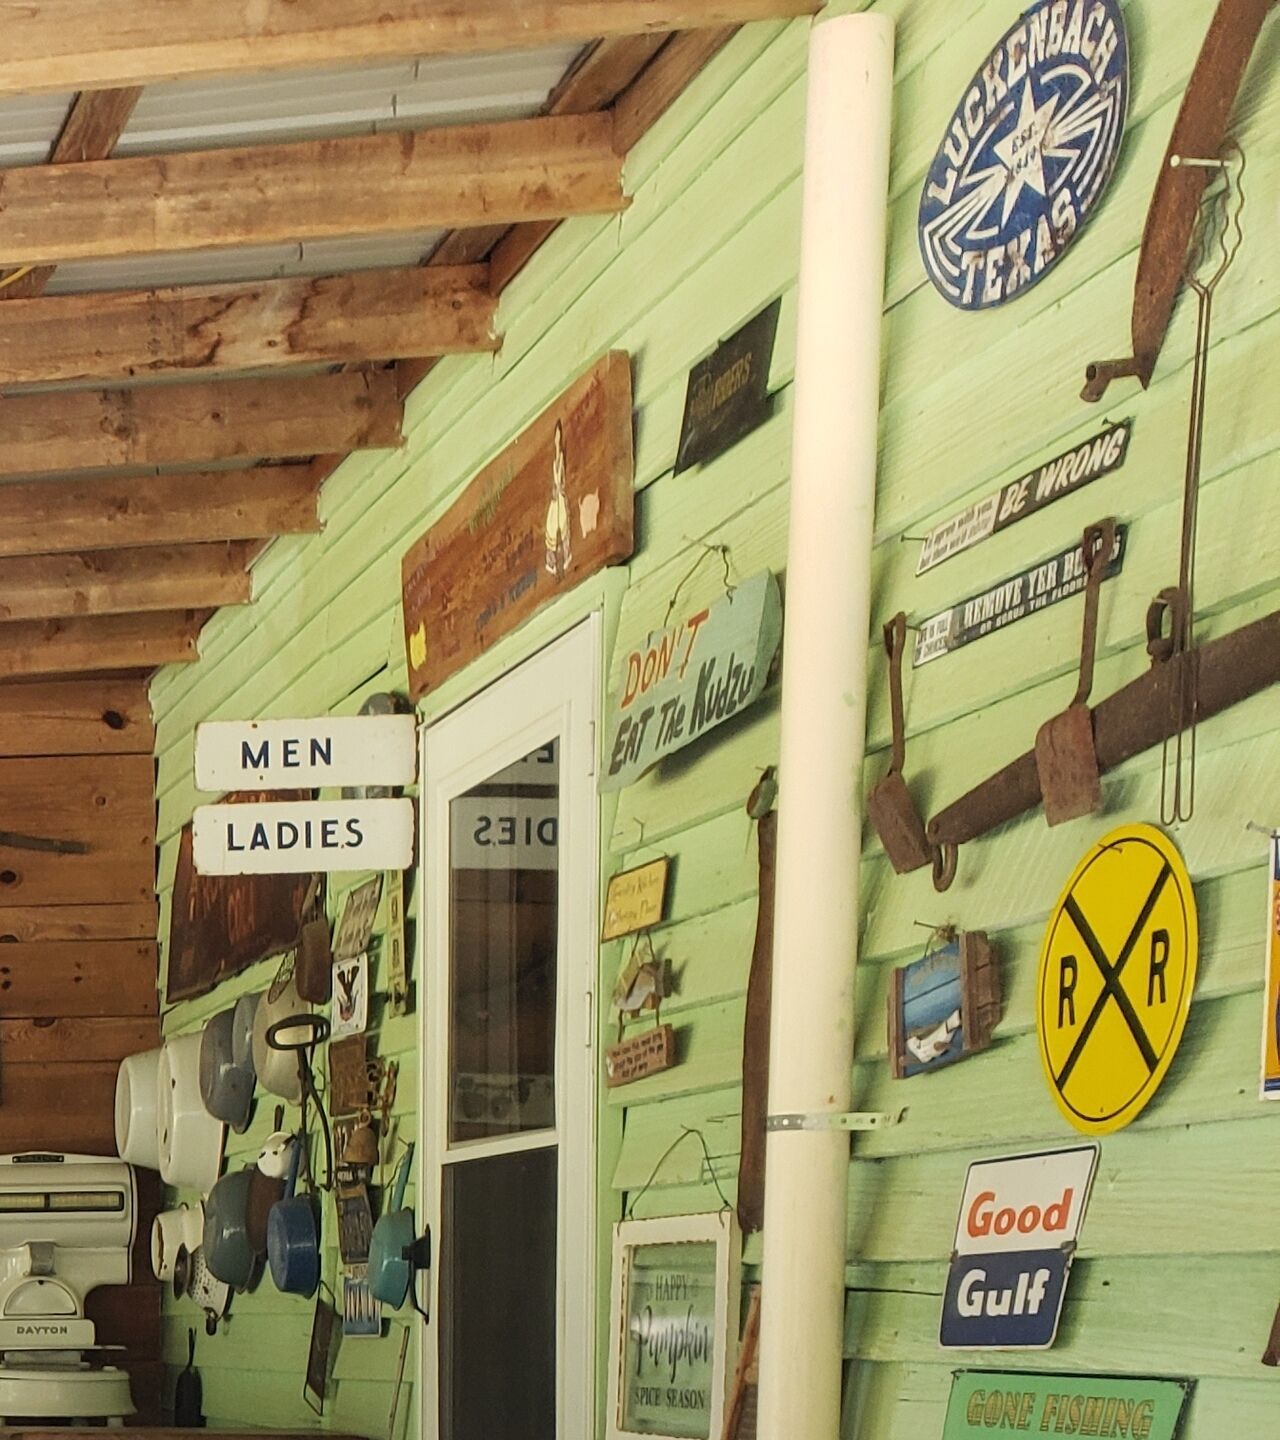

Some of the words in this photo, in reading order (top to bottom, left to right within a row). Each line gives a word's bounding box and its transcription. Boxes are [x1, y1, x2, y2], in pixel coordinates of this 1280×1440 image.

[928, 0, 1117, 205] LUCKENBACH
[961, 188, 1077, 304] TEXAS
[998, 479, 1032, 522] BE
[1035, 428, 1124, 504] WRONG
[964, 577, 1023, 629] REMOVE
[1027, 560, 1058, 599] YER
[621, 609, 710, 709] DON'T
[241, 737, 333, 769] MEN
[609, 709, 650, 777] EAT
[227, 818, 364, 851] LADIES
[1058, 954, 1077, 1029] R
[1147, 928, 1170, 1007] R
[966, 1188, 1074, 1238] Good
[655, 1273, 690, 1301] HAPPY
[956, 1268, 1050, 1318] Gulf
[16, 1326, 68, 1335] DAYTON
[635, 1303, 710, 1385] Pumpkin
[634, 1386, 660, 1408] SPICE
[665, 1389, 705, 1410] SEASON
[966, 1388, 1036, 1431] GONE
[1040, 1393, 1155, 1440] FISHING
